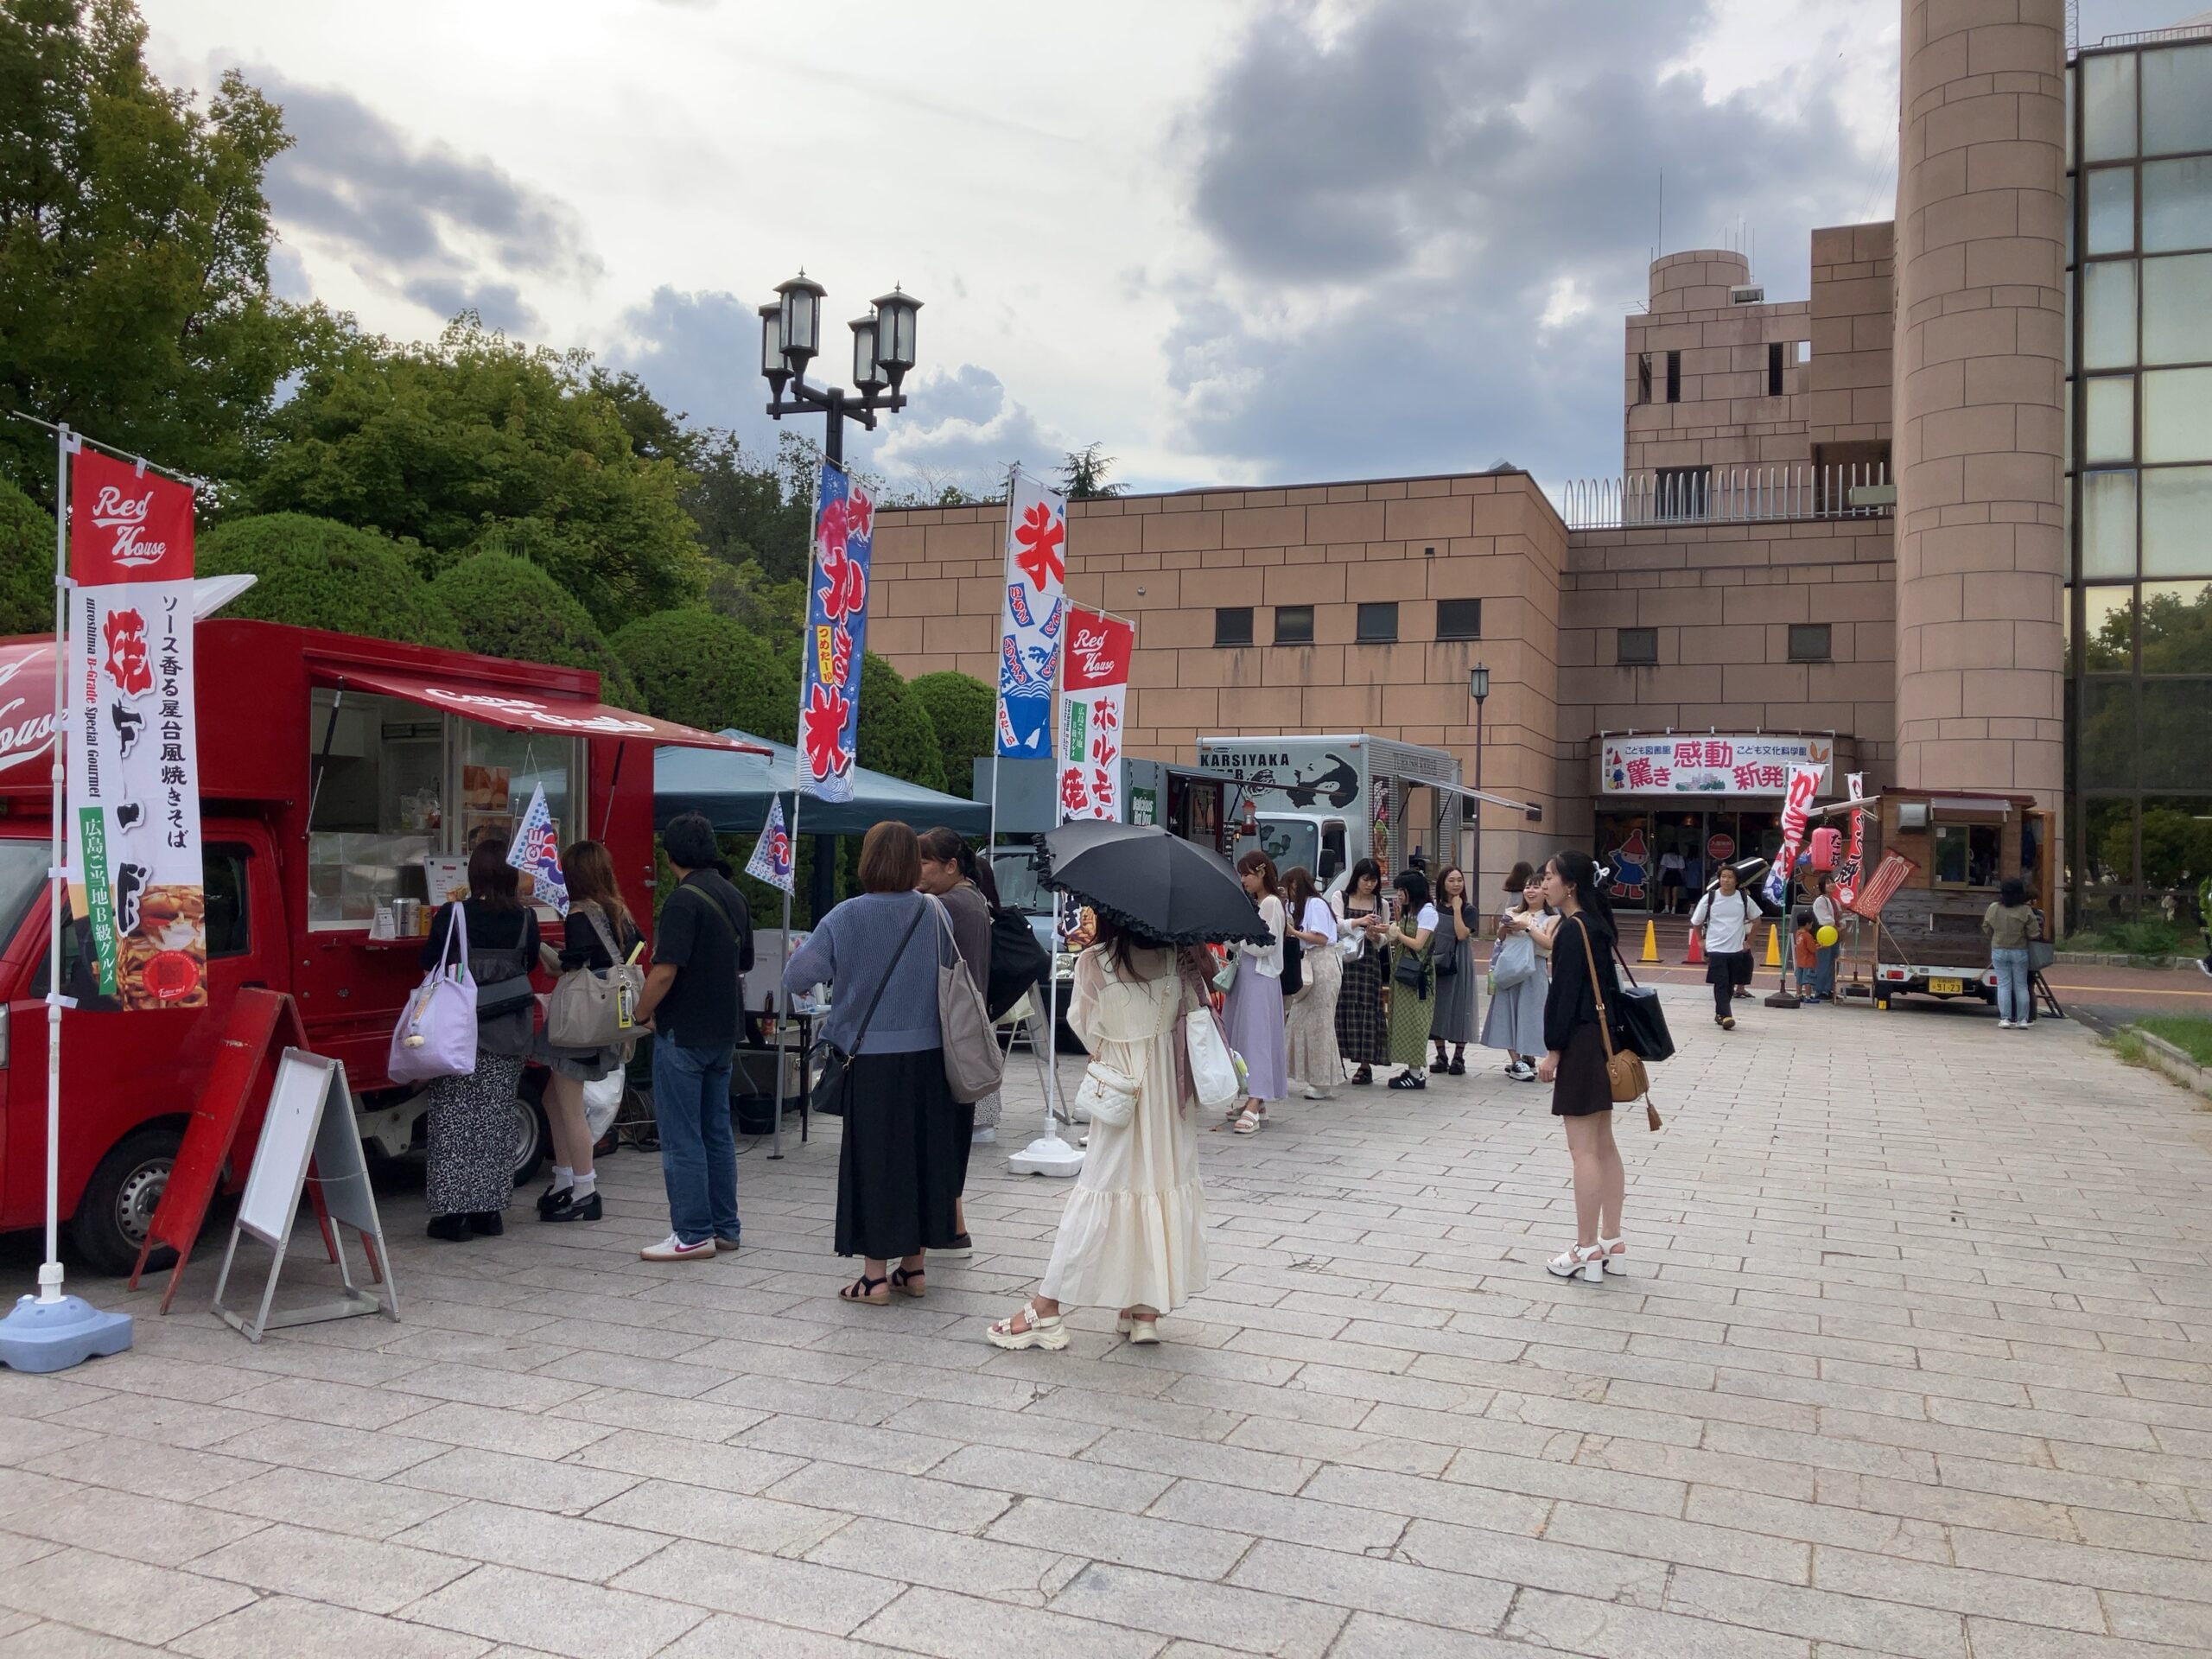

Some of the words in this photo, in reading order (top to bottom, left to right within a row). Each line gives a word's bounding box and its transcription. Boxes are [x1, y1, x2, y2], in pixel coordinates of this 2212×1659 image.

[92, 486, 154, 525] Red
[845, 485, 873, 538] 氷
[112, 525, 166, 566] House
[1014, 501, 1065, 593] 氷
[1009, 586, 1029, 625] いちご
[818, 627, 833, 683] つめたーい
[1072, 629, 1109, 654] Red
[86, 657, 98, 705] B-Grade
[804, 547, 866, 779] かき氷
[1083, 652, 1115, 678] House
[85, 706, 99, 747] Special
[158, 596, 188, 849] ソース香る屋台風焼きそば
[1200, 753, 1290, 767] KARSIYAKA
[1624, 745, 1671, 755] こども図書館
[1674, 741, 1732, 768] 感動
[1737, 745, 1807, 757] こども文化科学館
[87, 749, 101, 798] Gourmet
[1625, 757, 1672, 790] 驚き
[1732, 760, 1787, 791] 新発
[523, 828, 545, 870] ICE
[84, 817, 116, 984] 広島ご当地B級グルメ
